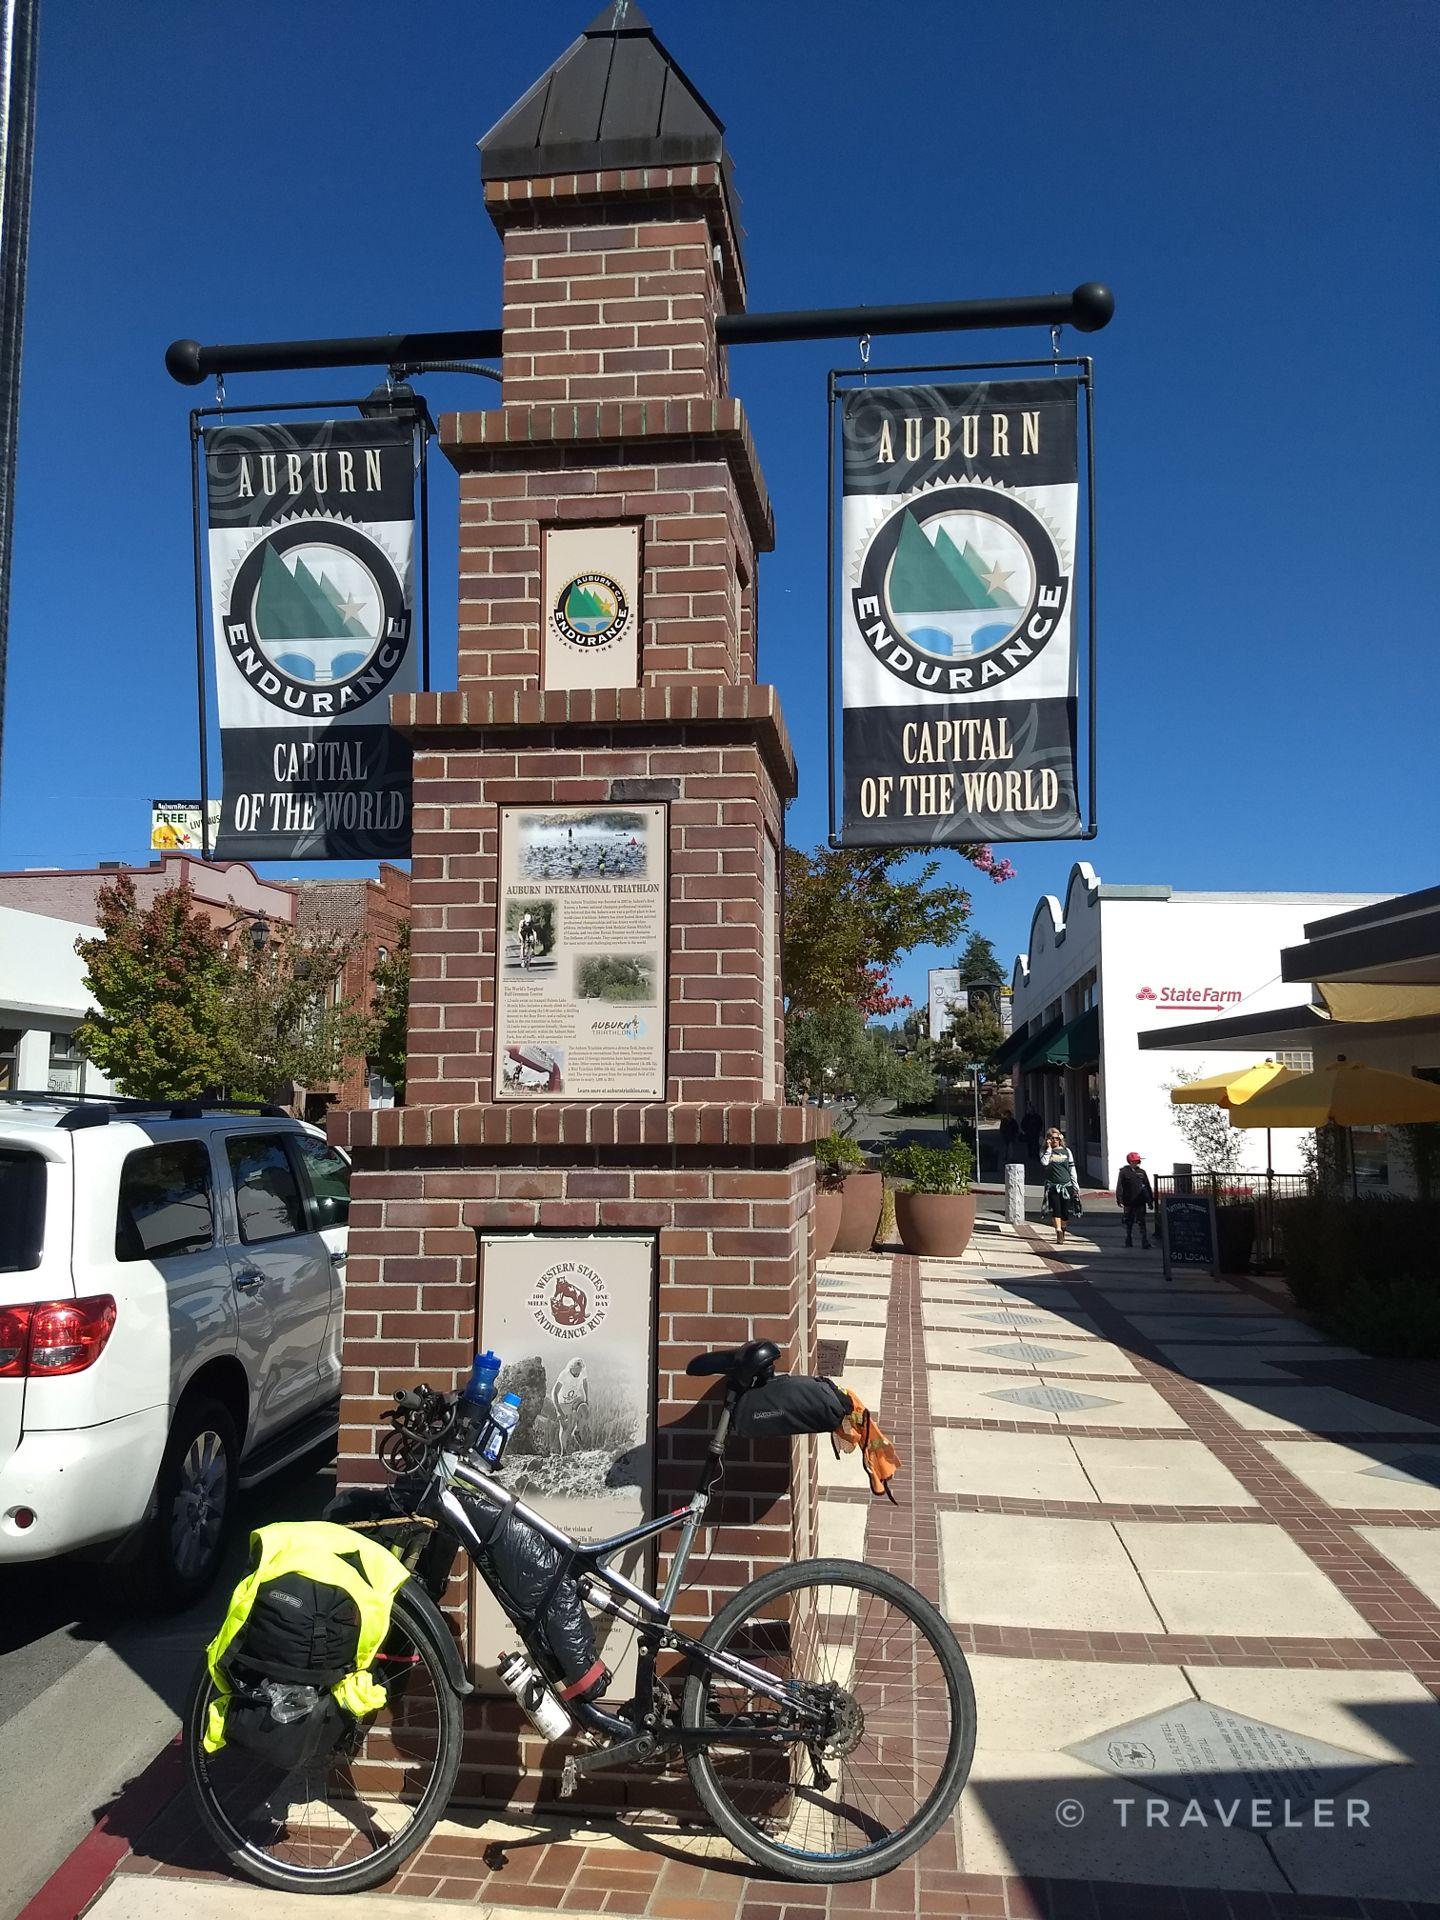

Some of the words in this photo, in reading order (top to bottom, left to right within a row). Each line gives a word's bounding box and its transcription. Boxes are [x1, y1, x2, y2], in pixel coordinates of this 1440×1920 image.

[876, 411, 1041, 463] AUBURN
[238, 449, 382, 497] AUBURN
[576, 575, 612, 587] AUBURN
[614, 589, 623, 602] CA
[555, 608, 627, 646] ENDURANCE
[857, 585, 1062, 690] ENDURANCE
[228, 616, 408, 713] ENDURANCE
[595, 644, 613, 653] THE
[902, 717, 1013, 764] CAPITAL
[273, 741, 368, 782] CAPITAL
[234, 793, 265, 832] OF
[269, 792, 317, 831] THE
[323, 790, 405, 831] WORLD
[860, 776, 893, 818] OF
[900, 773, 954, 817] THE
[961, 768, 1059, 814] WORLD
[156, 813, 187, 823] FREE!
[506, 885, 541, 895] AUBURN
[545, 884, 609, 895] INTERNATIONAL
[609, 883, 660, 894] TRIATHLON
[591, 1021, 631, 1030] AUBURN
[536, 1262, 575, 1290] WESTERN
[577, 1264, 605, 1292] STATES
[534, 1310, 588, 1339] ENDURANCE
[588, 1310, 606, 1331] RUN
